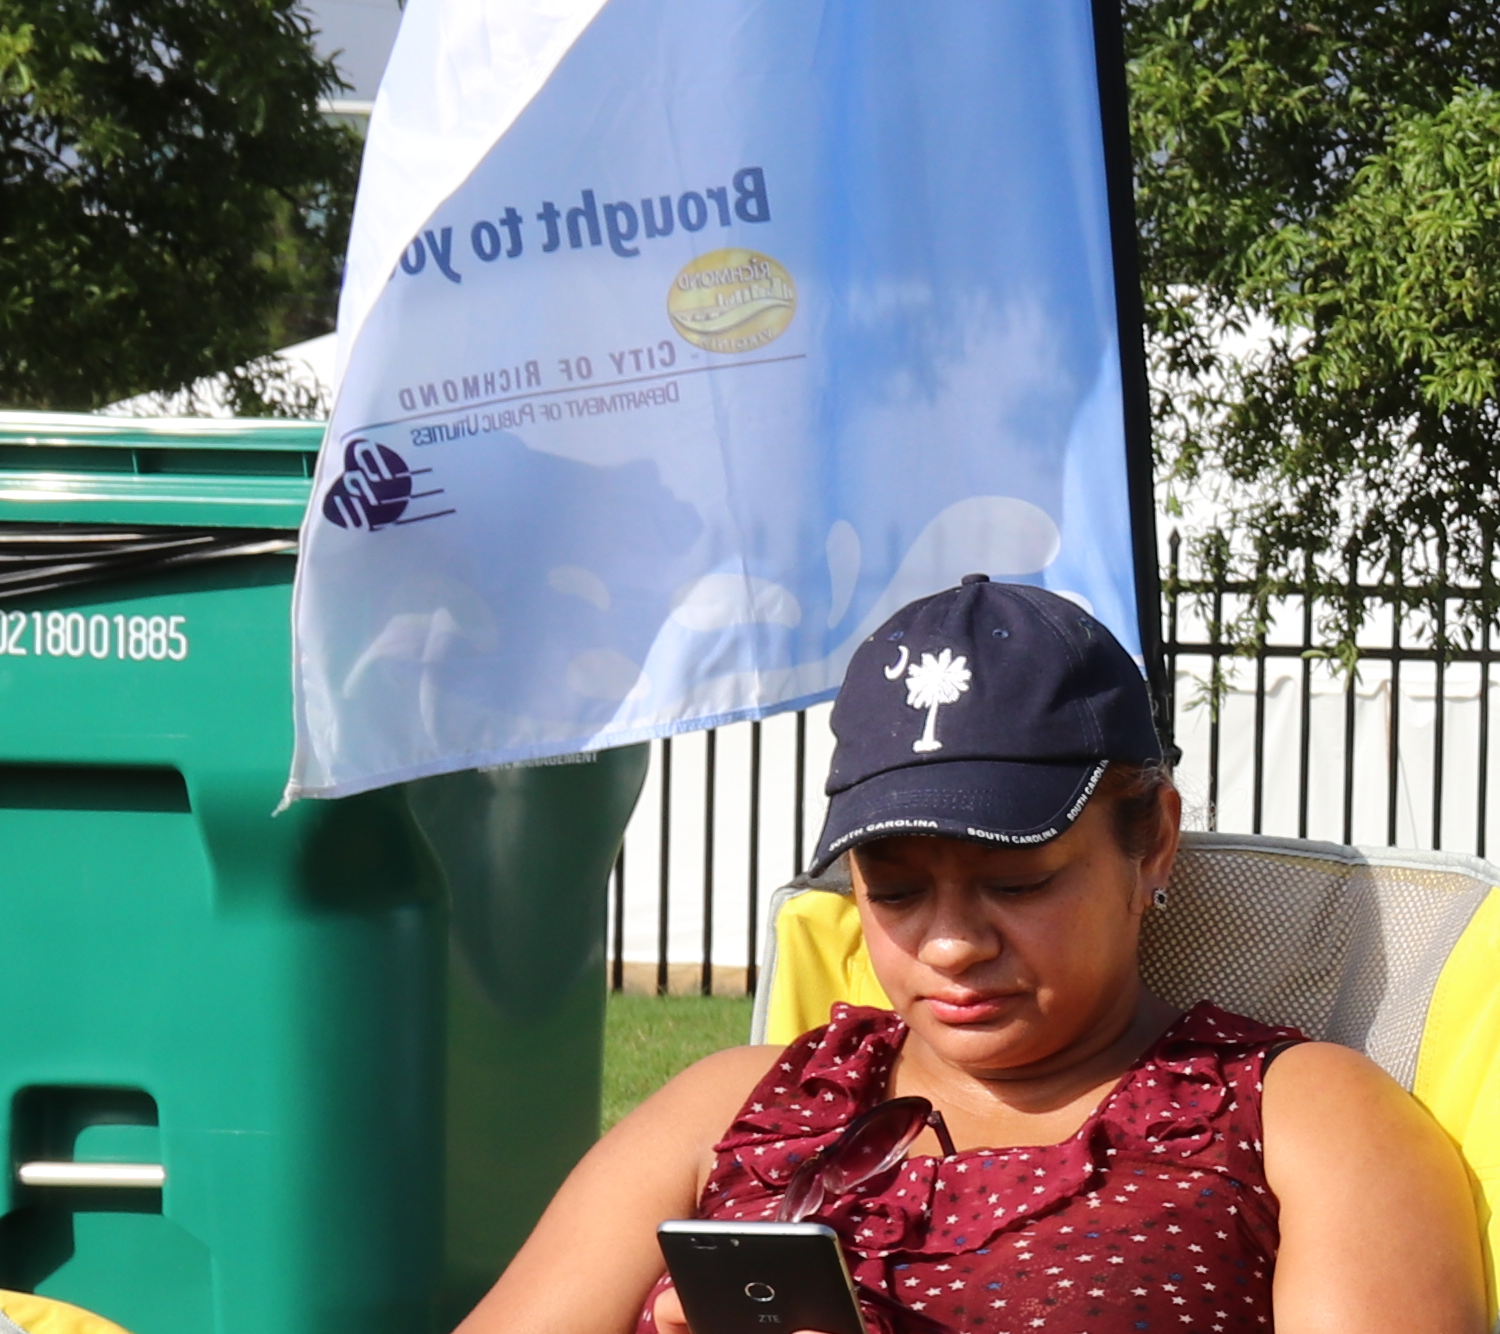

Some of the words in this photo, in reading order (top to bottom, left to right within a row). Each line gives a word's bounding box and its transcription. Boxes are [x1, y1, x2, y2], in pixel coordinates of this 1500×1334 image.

[1066, 793, 1088, 822] SOUTH
[828, 826, 864, 852] SOUTH
[866, 818, 938, 833] CAROLINA
[966, 826, 1010, 844] SOUTH
[1012, 826, 1058, 845] CAROLINA
[758, 1314, 781, 1323] ZTE
